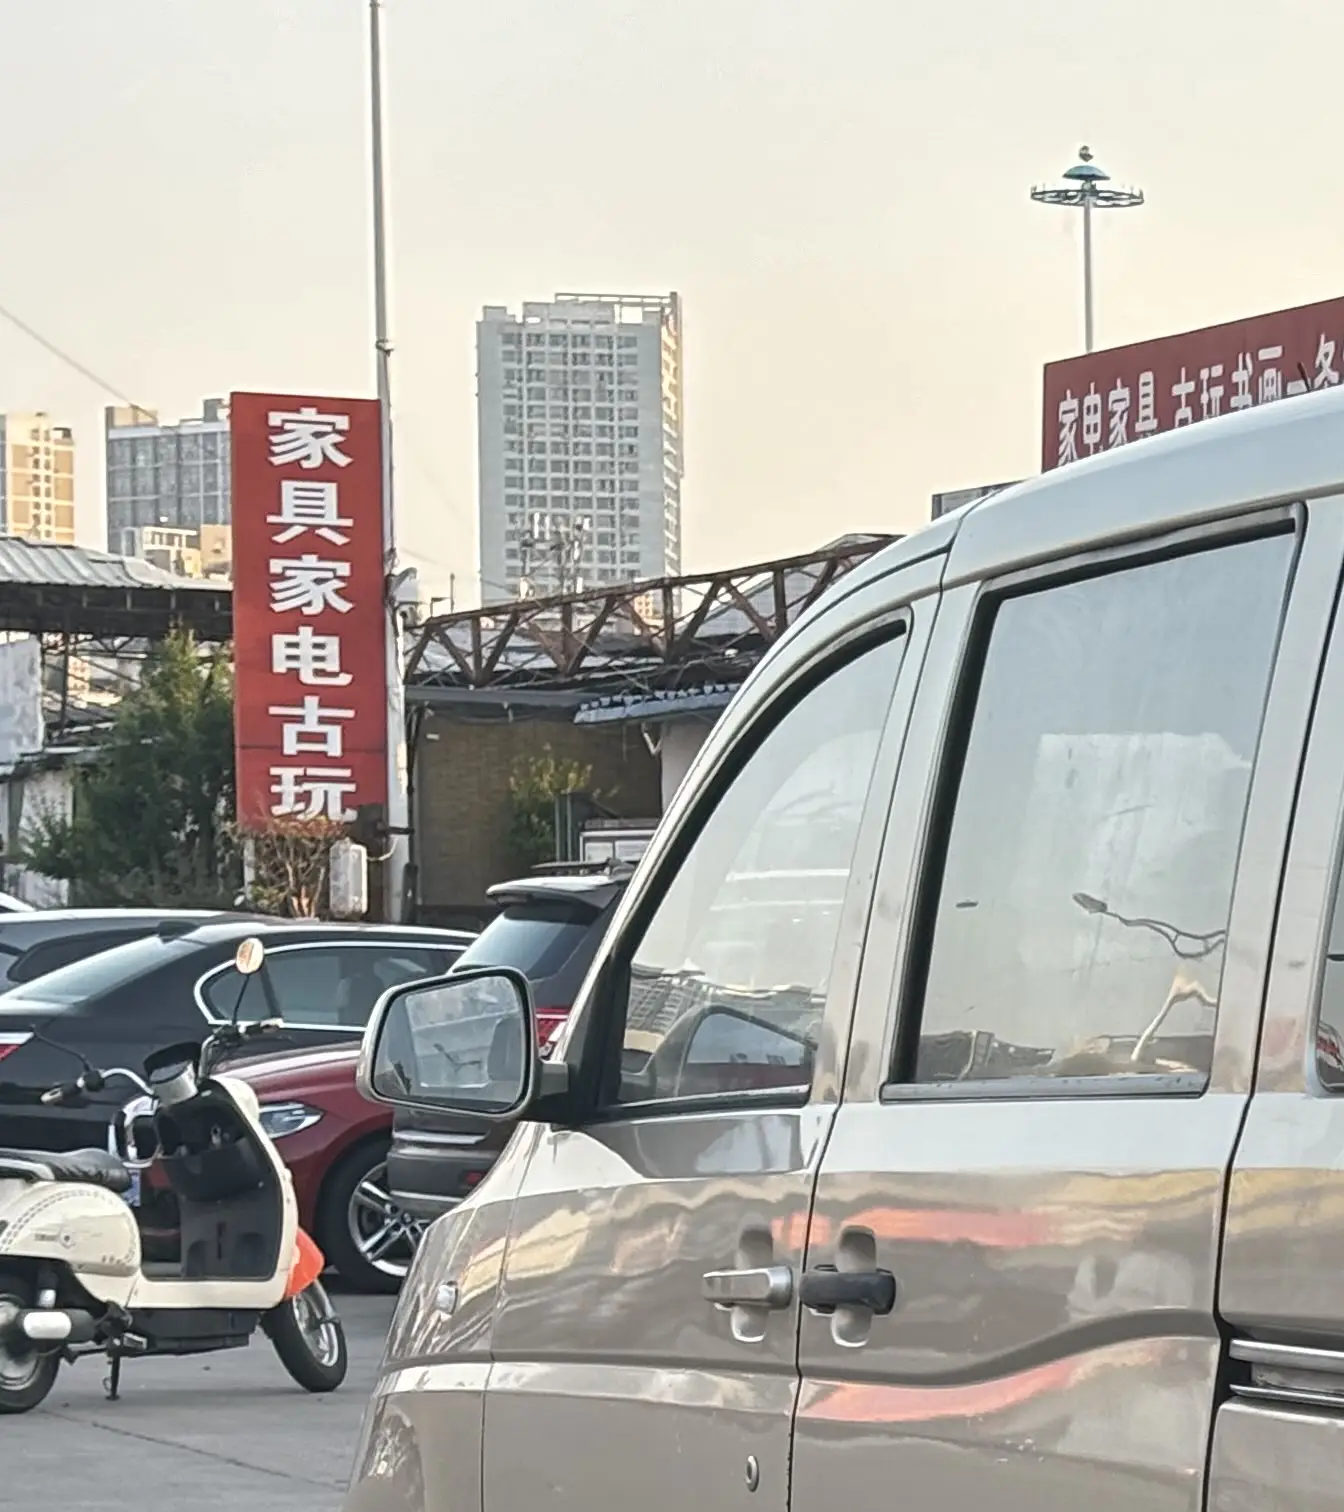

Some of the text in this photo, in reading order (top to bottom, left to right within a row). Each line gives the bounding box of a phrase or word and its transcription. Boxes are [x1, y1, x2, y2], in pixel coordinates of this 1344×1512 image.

[266, 407, 358, 824] 家具家电古玩
